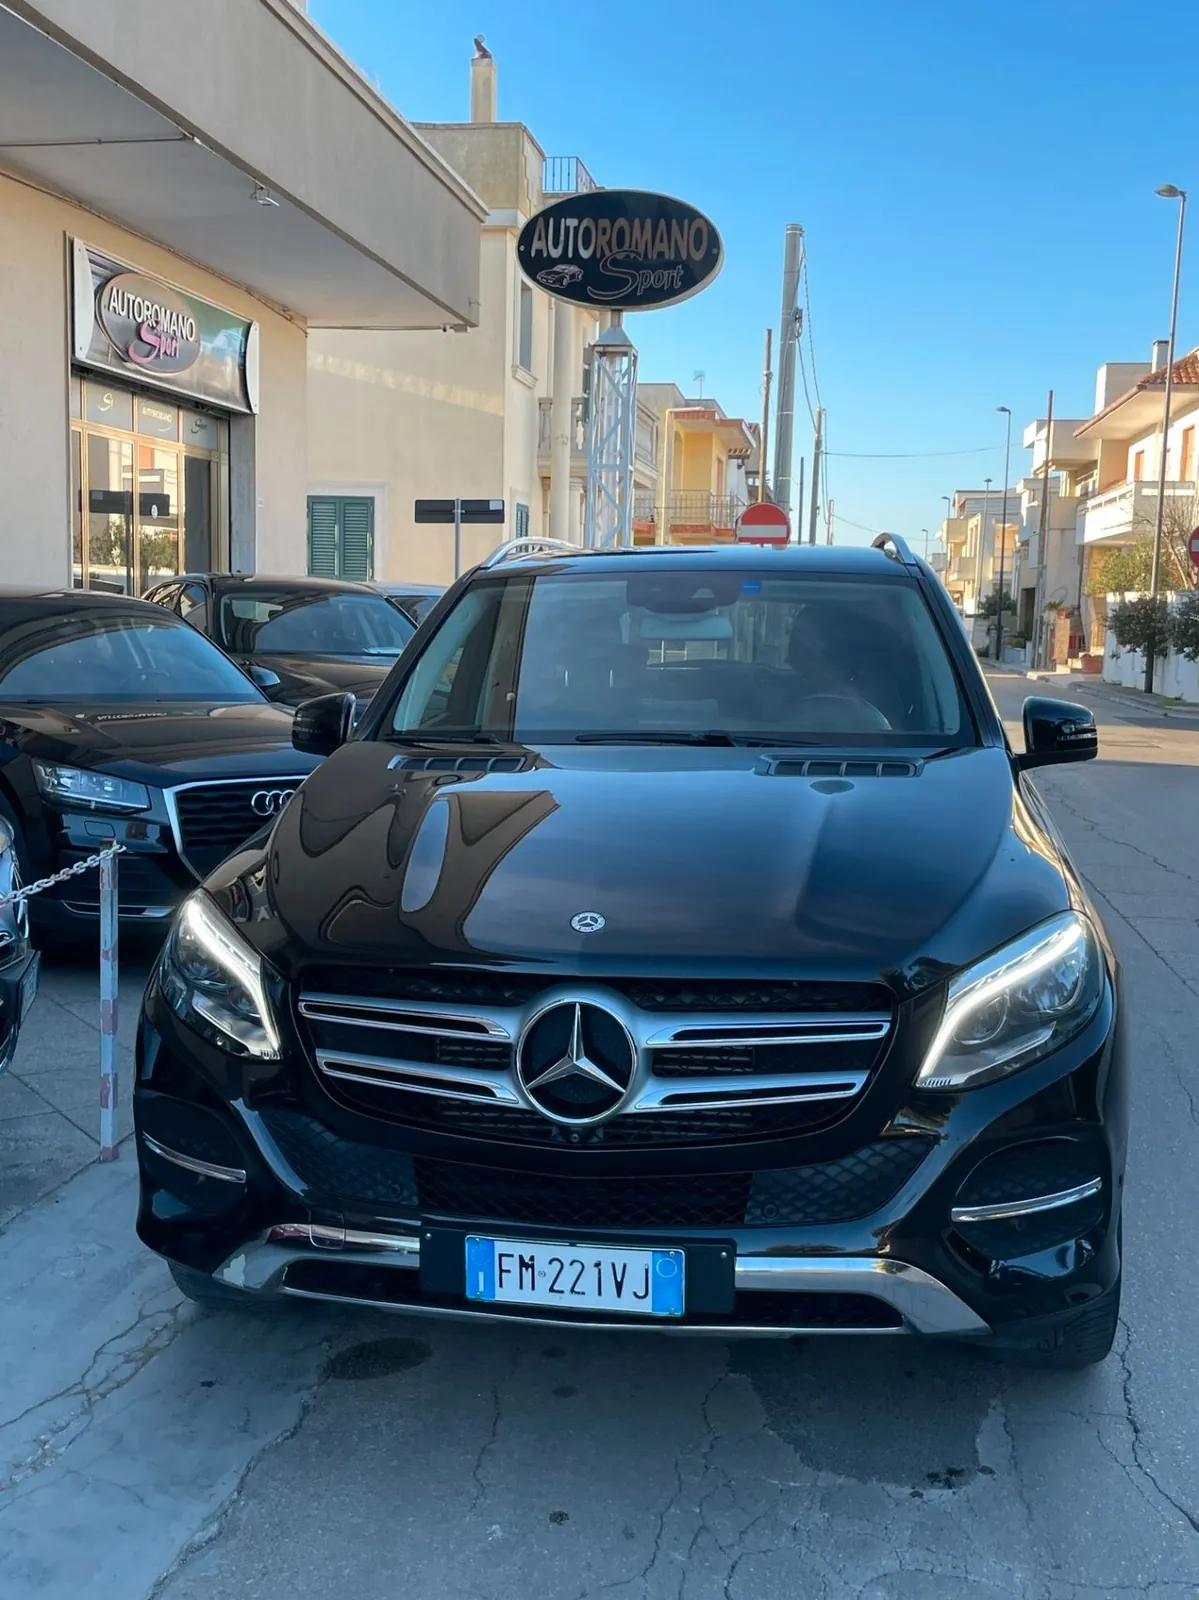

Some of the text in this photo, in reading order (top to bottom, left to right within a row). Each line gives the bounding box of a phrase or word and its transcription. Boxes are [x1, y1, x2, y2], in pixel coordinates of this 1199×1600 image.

[530, 216, 709, 262] AUTOROMANO
[586, 249, 684, 301] Sport
[108, 286, 196, 342] AUTOROMANO
